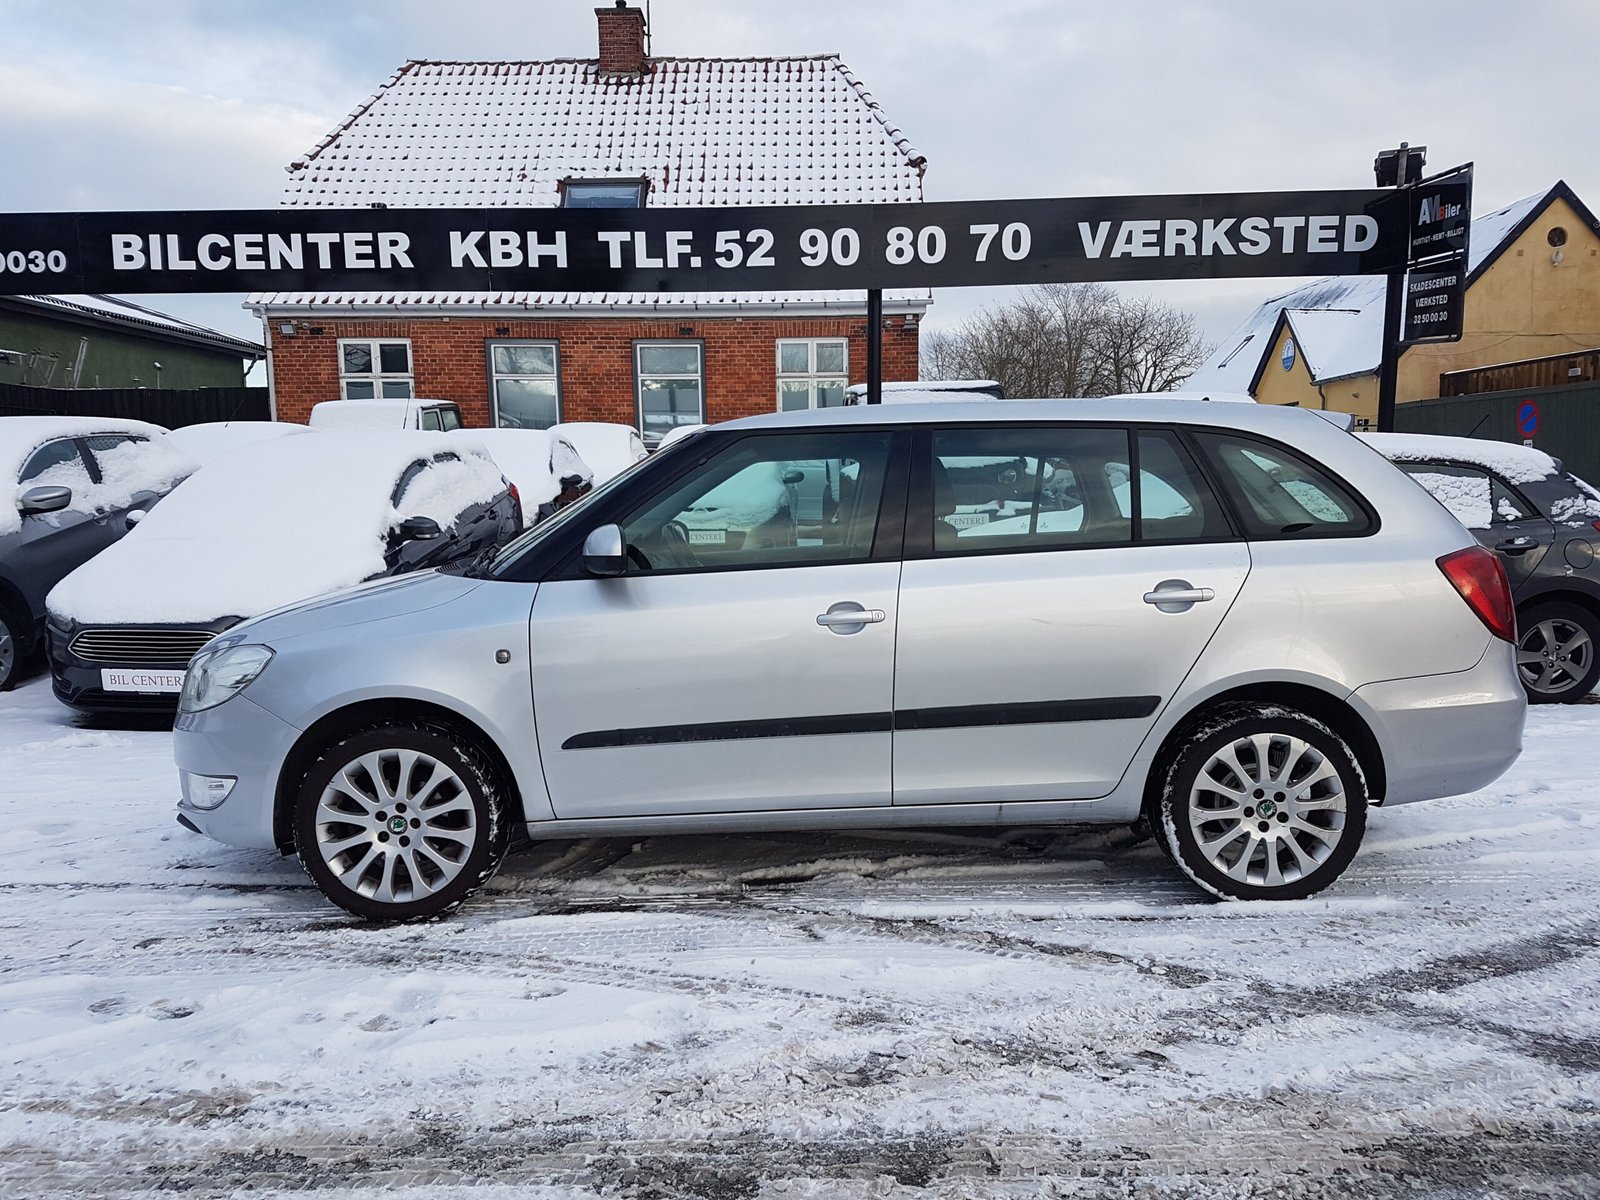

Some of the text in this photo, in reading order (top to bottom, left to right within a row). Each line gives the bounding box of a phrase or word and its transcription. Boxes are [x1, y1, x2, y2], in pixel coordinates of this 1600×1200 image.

[112, 215, 1378, 270] BILCENTER KBH TLF. 52 90 80 70 VÆRKSTED
[0, 250, 66, 273] 030
[1410, 276, 1457, 292] SKADESCENTER
[1415, 294, 1448, 307] VÆRKSTED
[109, 675, 183, 686] BIL CENTER
